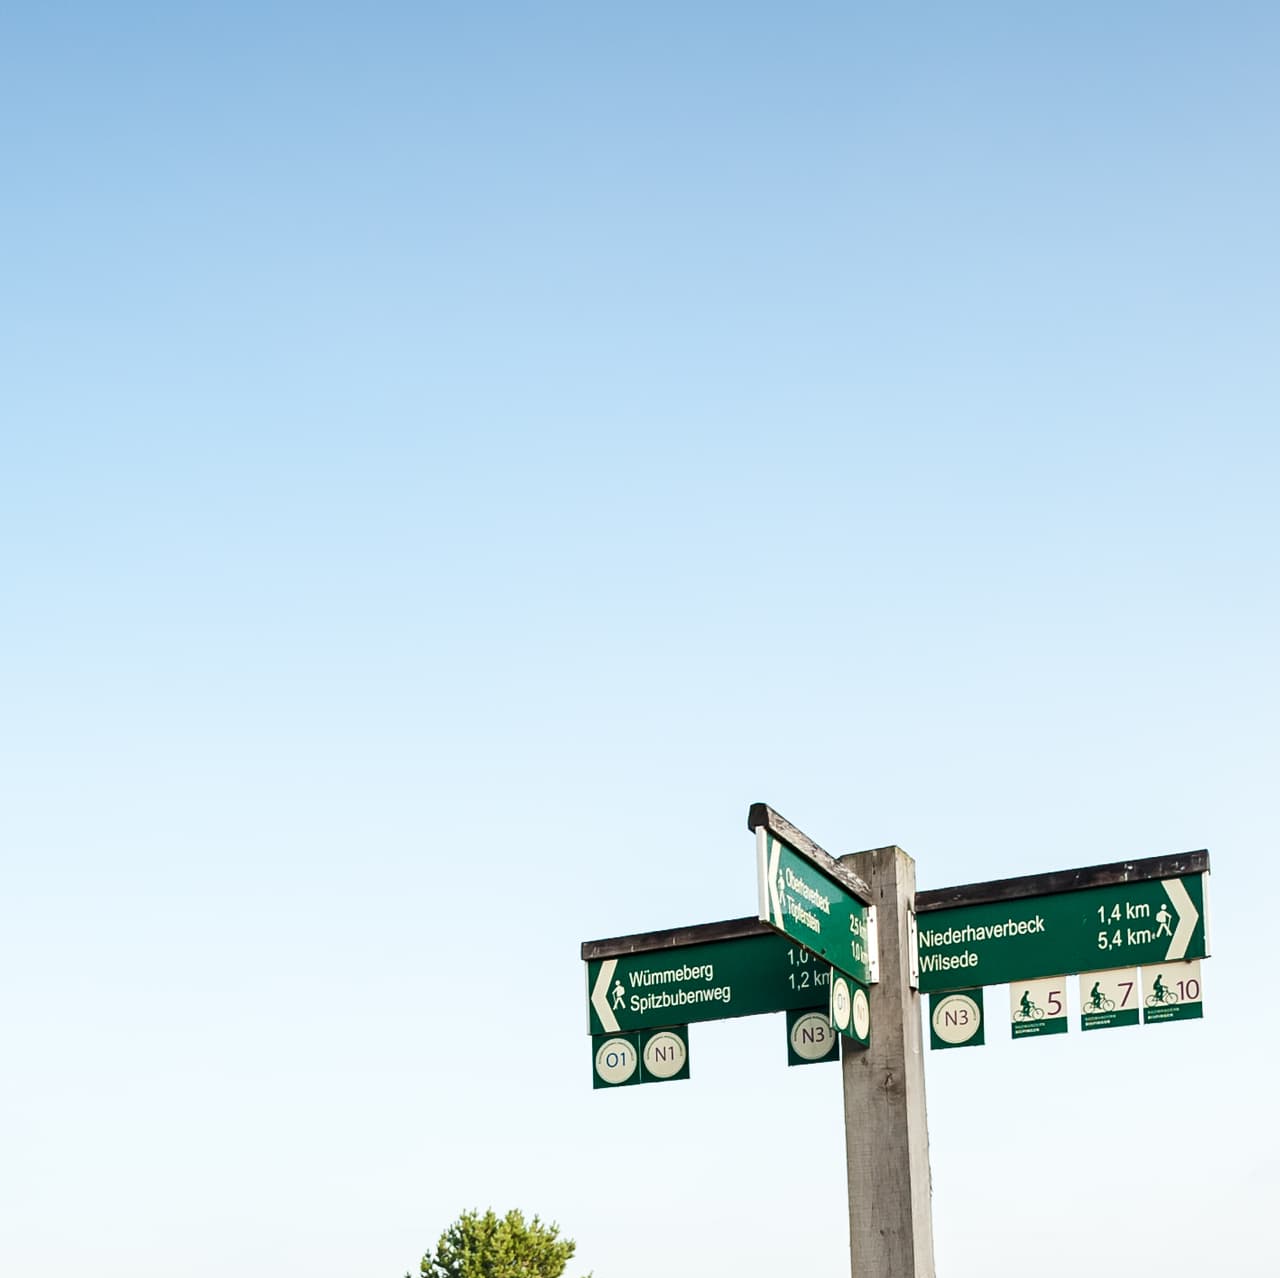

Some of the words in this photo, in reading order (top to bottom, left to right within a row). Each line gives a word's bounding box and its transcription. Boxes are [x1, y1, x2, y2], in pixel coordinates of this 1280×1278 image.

[919, 915, 1045, 948] Niederhaverbeck
[1097, 904, 1121, 925] 1,4
[1126, 902, 1150, 920] km
[919, 951, 978, 973] Wilsede
[1097, 931, 1122, 951] 5,4
[1127, 928, 1151, 946] km
[630, 964, 713, 987] Wümmeberg
[631, 986, 730, 1014] Spitzbubenweg
[788, 971, 810, 991] 1,2
[1117, 982, 1134, 1008] 7
[1176, 979, 1200, 1001] 10
[1047, 991, 1062, 1016] 5
[945, 1009, 969, 1027] N3
[802, 1028, 825, 1044] N3
[655, 1046, 675, 1062] N1
